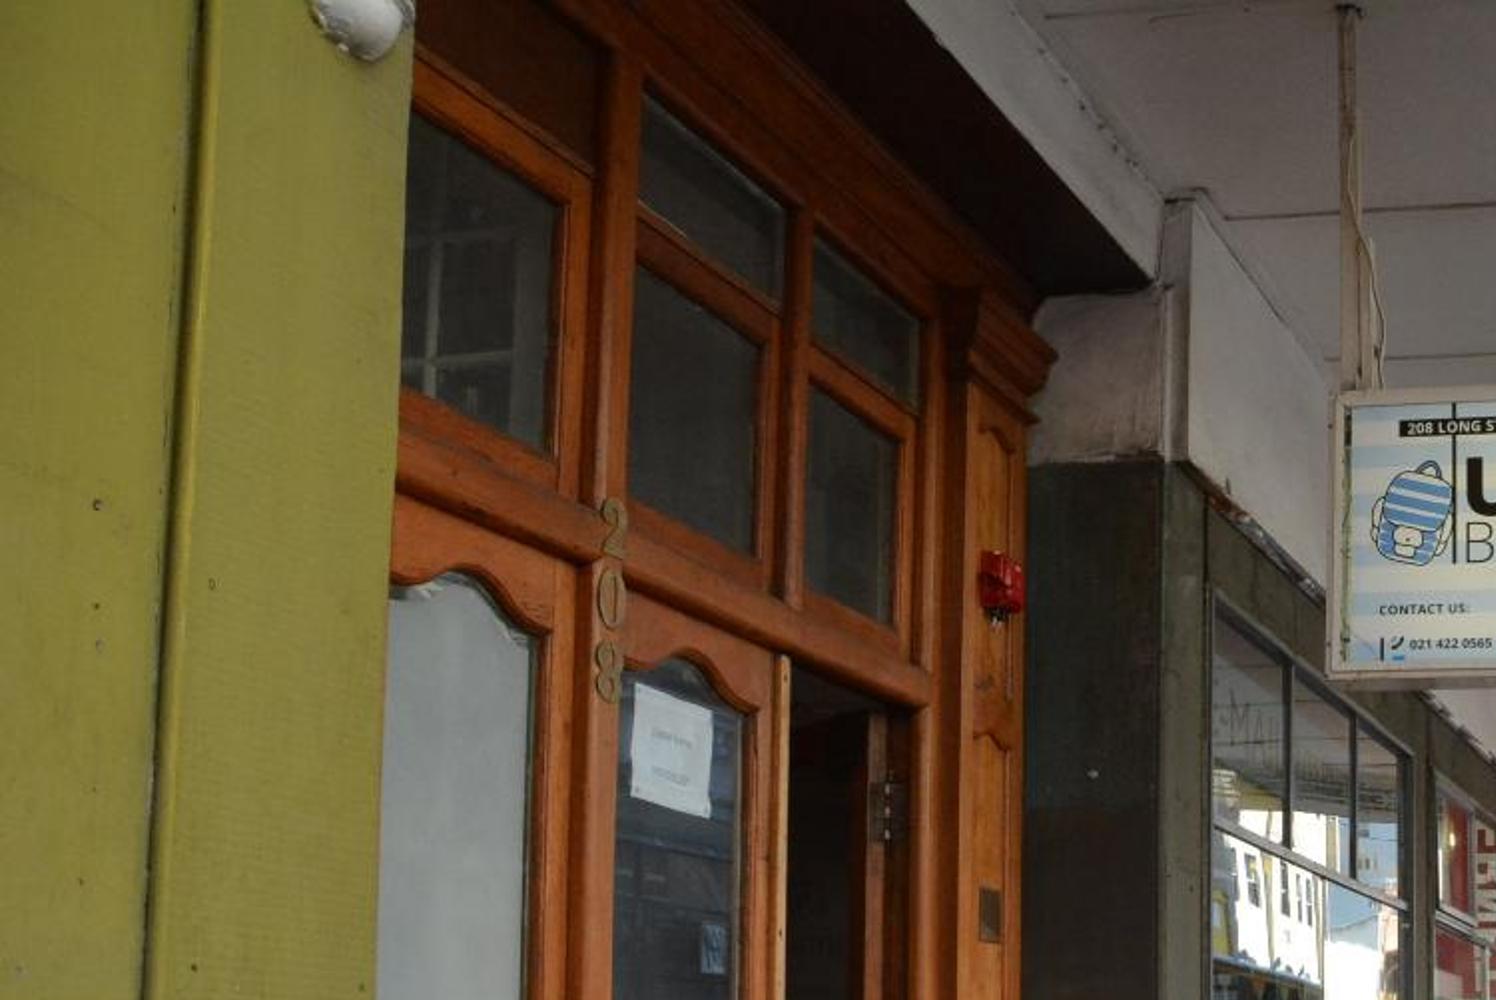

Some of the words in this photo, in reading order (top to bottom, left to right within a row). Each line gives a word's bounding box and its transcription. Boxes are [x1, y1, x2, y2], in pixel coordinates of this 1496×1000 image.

[1407, 422, 1433, 435] 208
[1438, 420, 1481, 433] LONG
[1379, 604, 1444, 616] CONTACT
[1409, 639, 1431, 650] 021
[1436, 638, 1459, 649] 422
